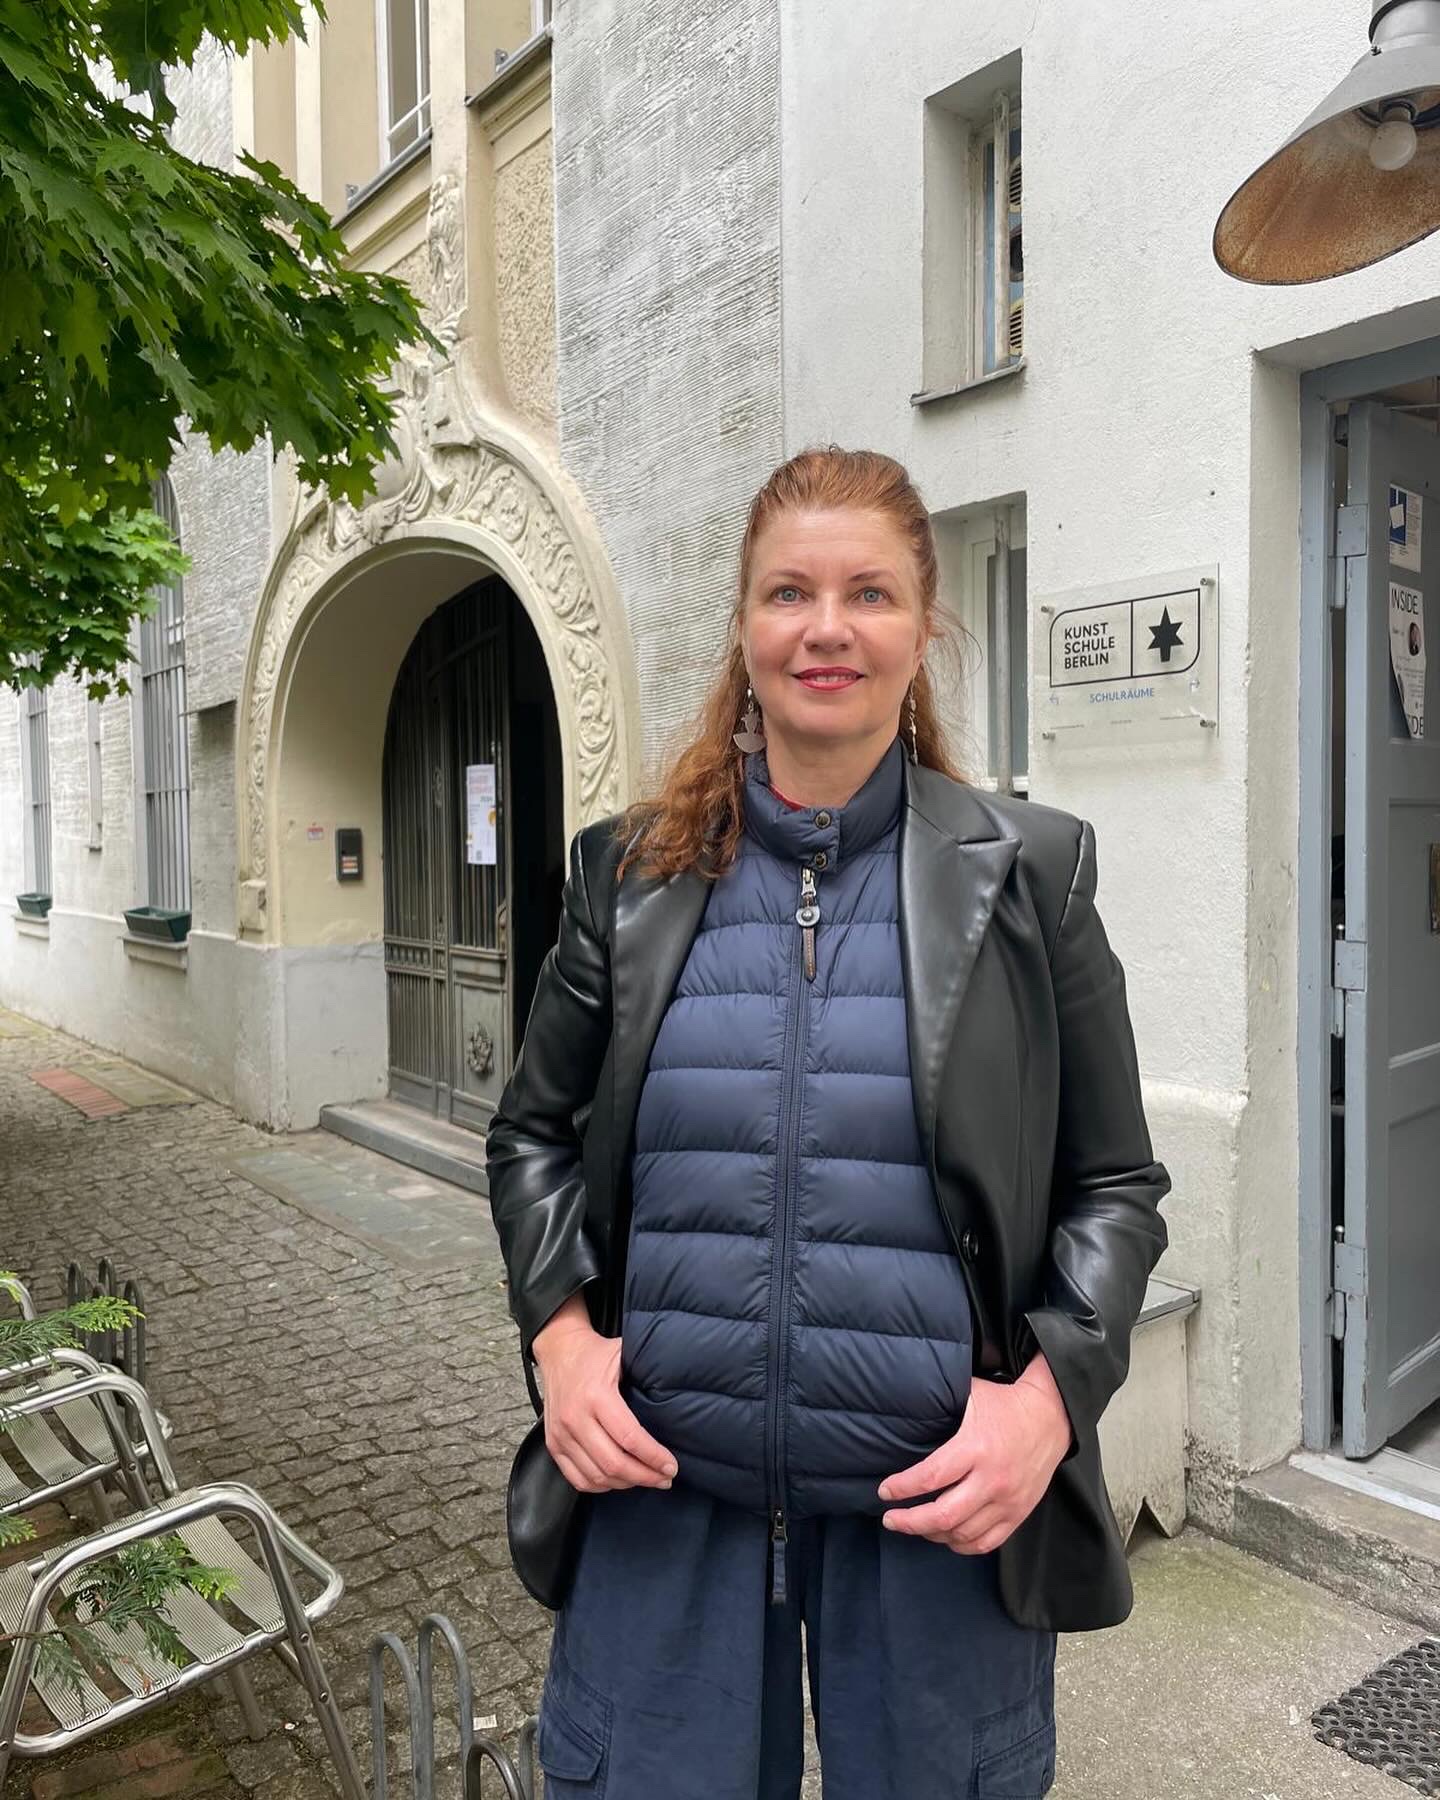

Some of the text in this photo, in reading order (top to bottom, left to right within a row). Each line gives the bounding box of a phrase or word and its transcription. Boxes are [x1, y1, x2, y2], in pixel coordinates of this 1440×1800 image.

[1391, 588, 1419, 615] INSIDE
[1064, 622, 1109, 640] KUNST
[1064, 636, 1115, 655] SCHULE
[1064, 652, 1109, 670] BERLIN
[1090, 688, 1155, 704] SCHULRÄUME
